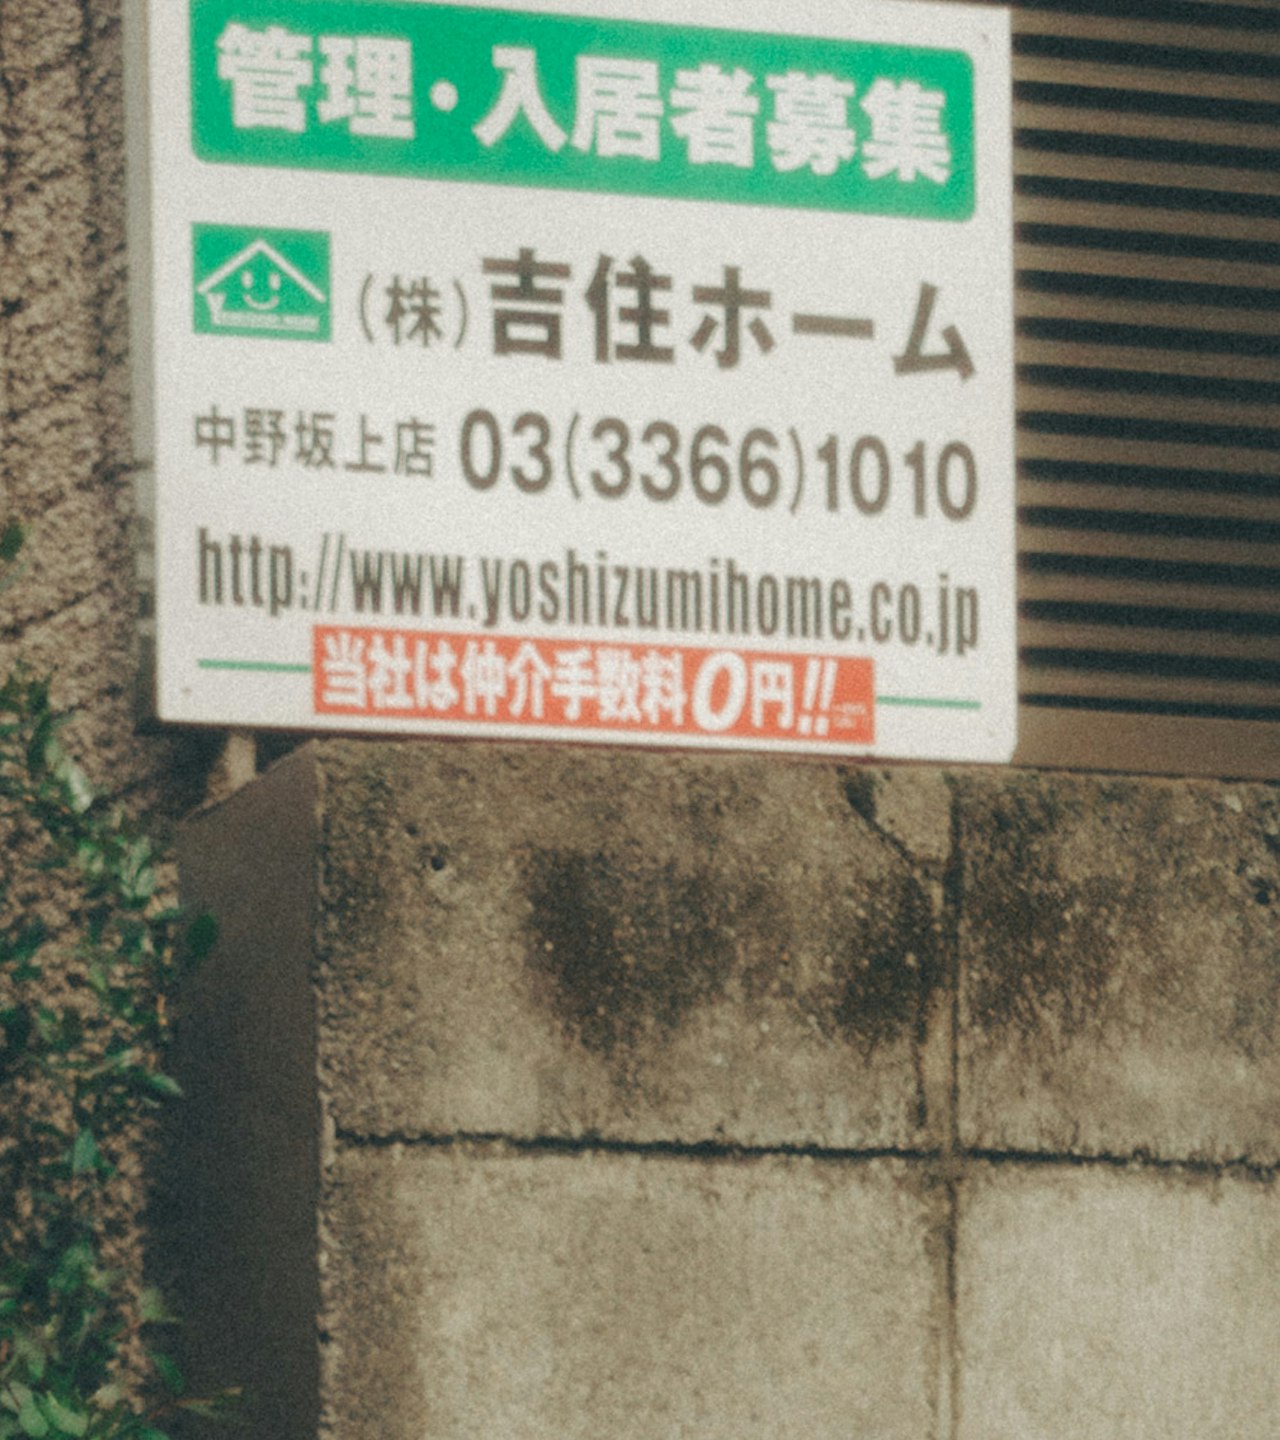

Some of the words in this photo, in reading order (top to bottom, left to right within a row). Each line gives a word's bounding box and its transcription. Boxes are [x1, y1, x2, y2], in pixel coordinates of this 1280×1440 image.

[216, 22, 951, 185] 管理・入居者募集
[194, 404, 437, 478] 中野坂上店
[458, 407, 978, 522] 03(3366)1010
[197, 527, 980, 657] http://www.yoshizumihome.co.jp
[322, 632, 838, 736] 当社は仲介手数料0円!!
